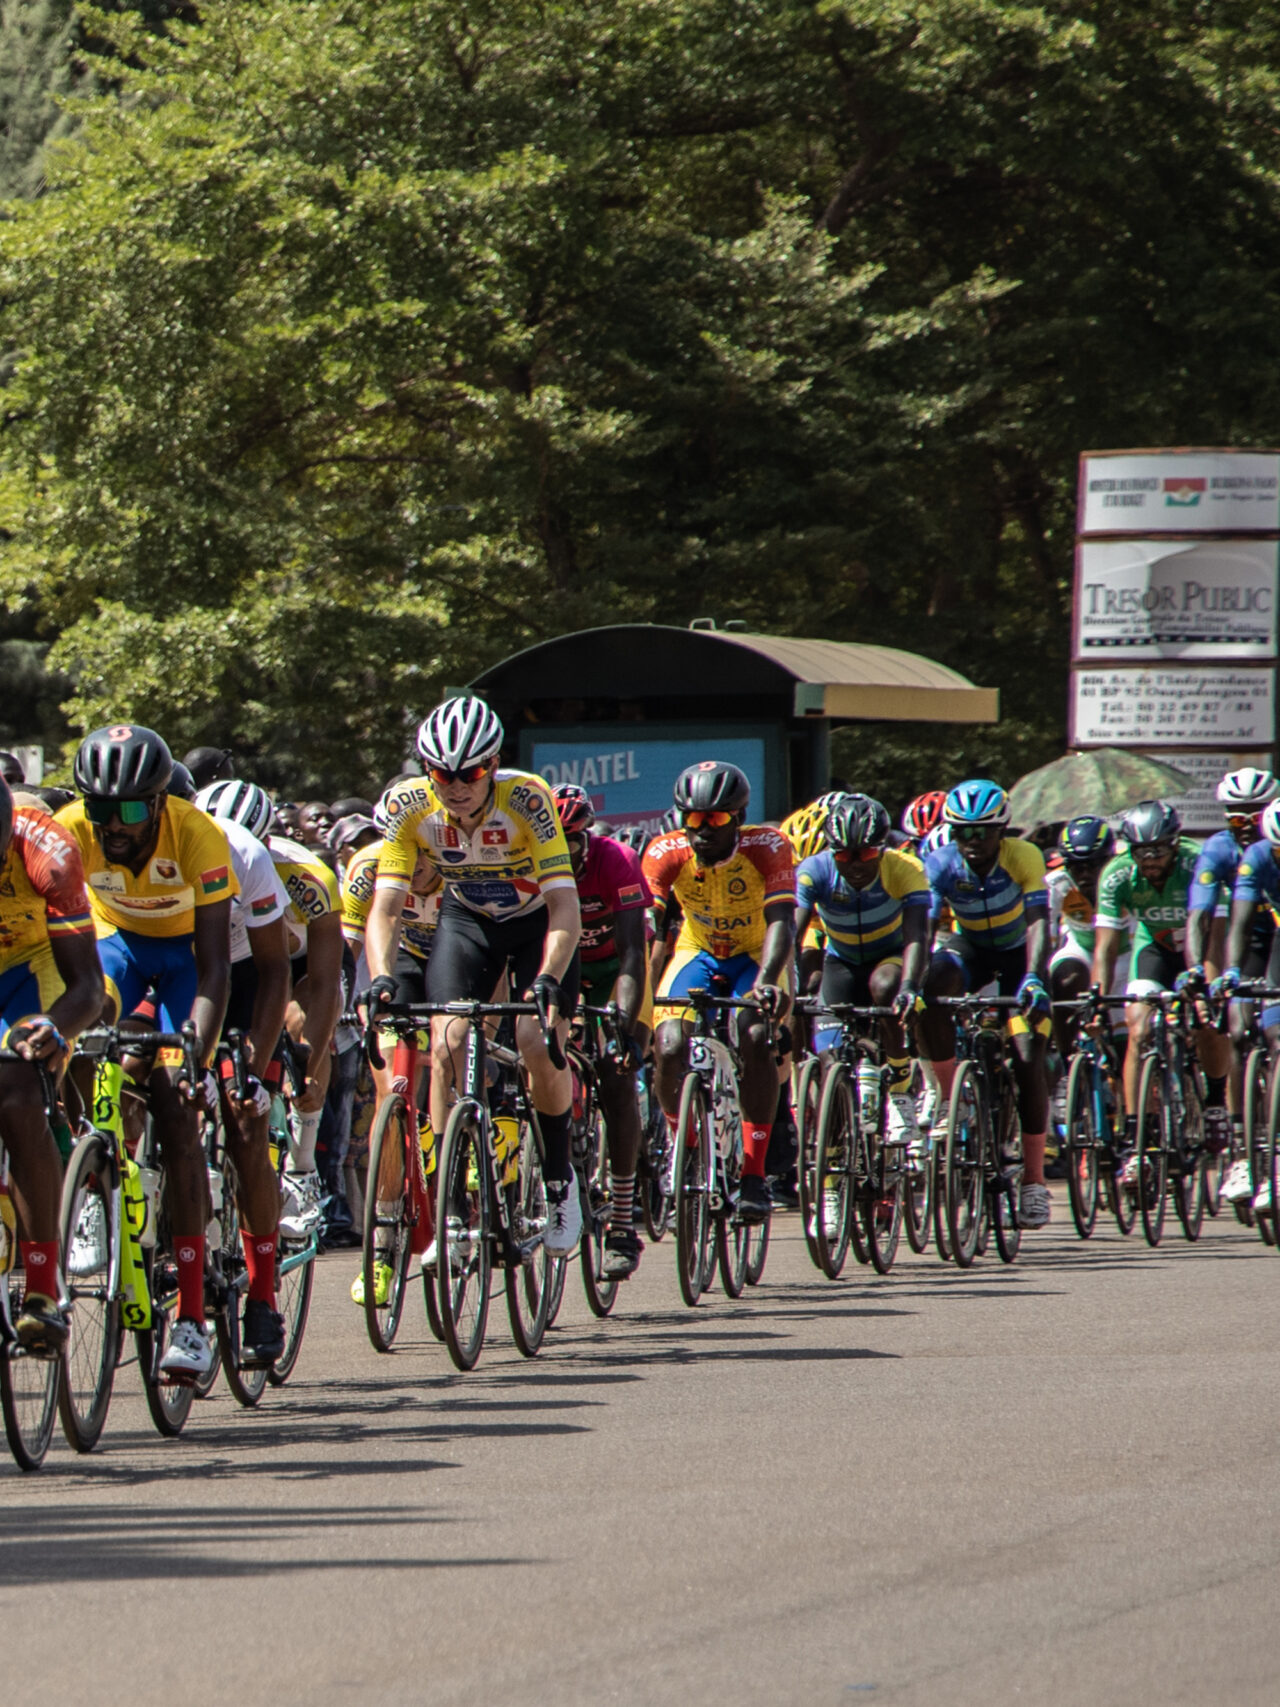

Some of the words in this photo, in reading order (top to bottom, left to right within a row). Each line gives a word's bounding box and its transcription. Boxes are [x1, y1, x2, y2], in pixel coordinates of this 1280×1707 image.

[1183, 581, 1272, 612] PUBLIC
[511, 786, 557, 840] PRODIS
[715, 916, 752, 930] BAI
[466, 1031, 477, 1095] FOCUS
